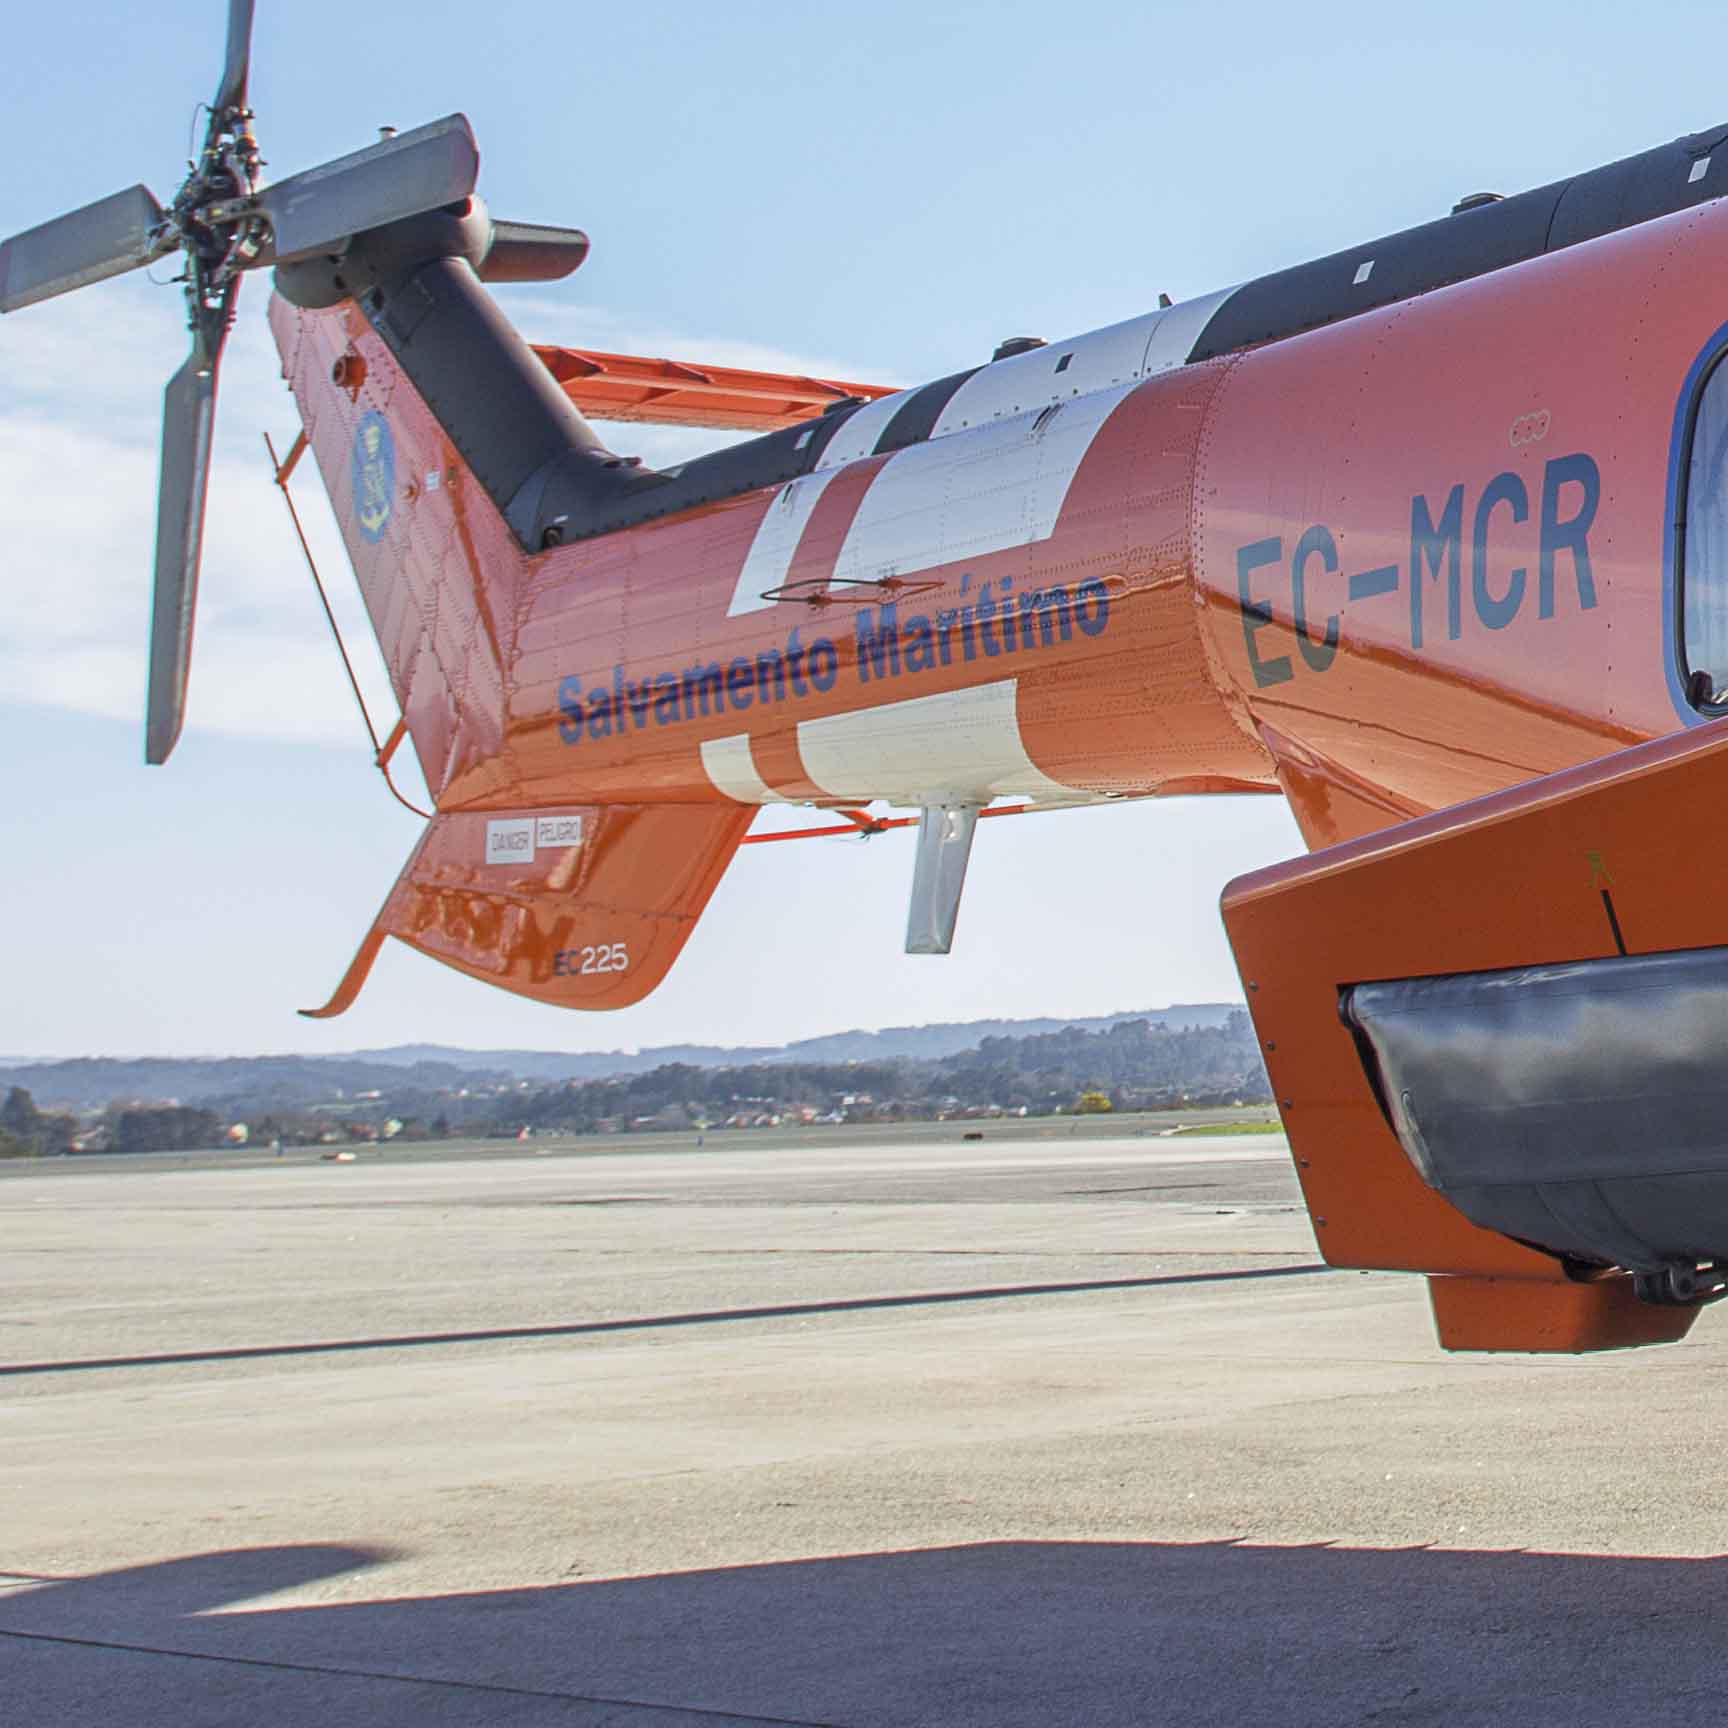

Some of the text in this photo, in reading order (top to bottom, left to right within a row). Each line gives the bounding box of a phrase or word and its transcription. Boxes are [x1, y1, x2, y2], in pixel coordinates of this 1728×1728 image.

[1236, 452, 1602, 688] EC-MCR
[558, 572, 1111, 746] Salvamento Marítimo
[554, 942, 629, 976] EC225
